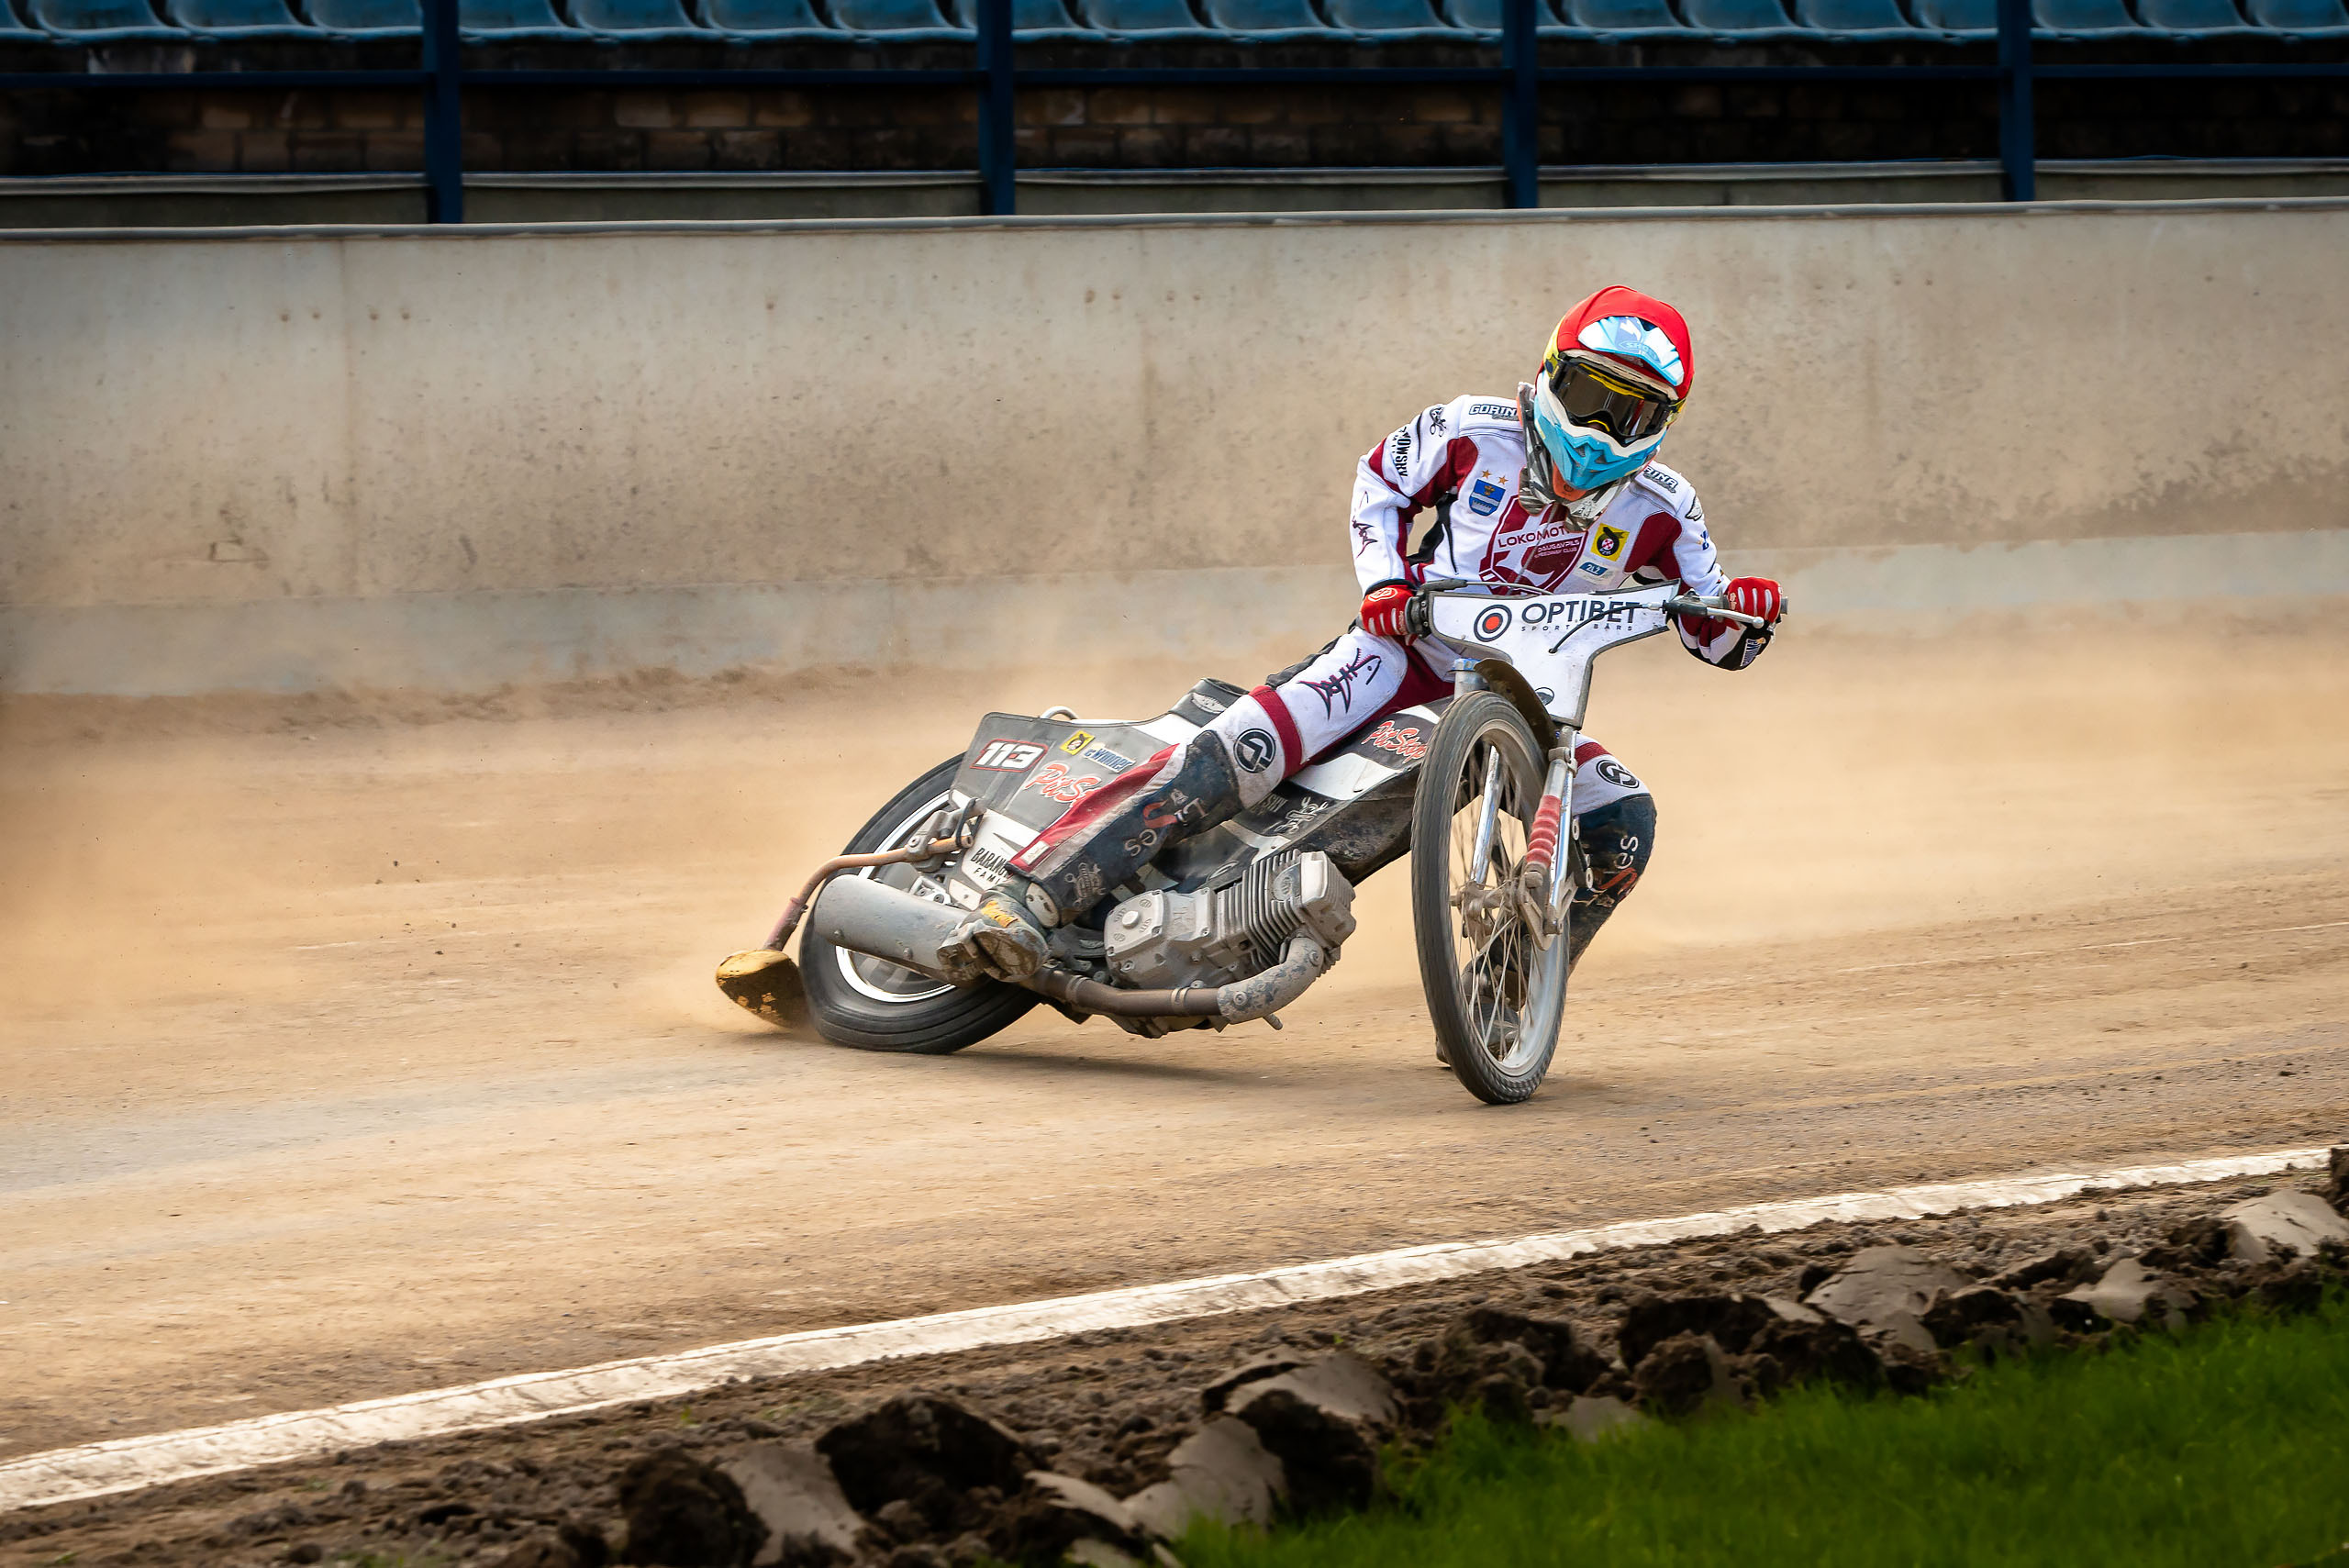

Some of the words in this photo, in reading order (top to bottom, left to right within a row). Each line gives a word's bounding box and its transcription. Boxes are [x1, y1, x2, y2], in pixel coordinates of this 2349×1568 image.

[1469, 404, 1518, 417] GORIN
[1497, 525, 1569, 548] LOKOMOT
[1521, 599, 1640, 624] OPTIBET
[1593, 623, 1632, 631] BARS
[974, 741, 1044, 769] 113
[1023, 762, 1101, 805] PitS
[971, 848, 1010, 878] BARANO
[974, 867, 1000, 884] FAMI
